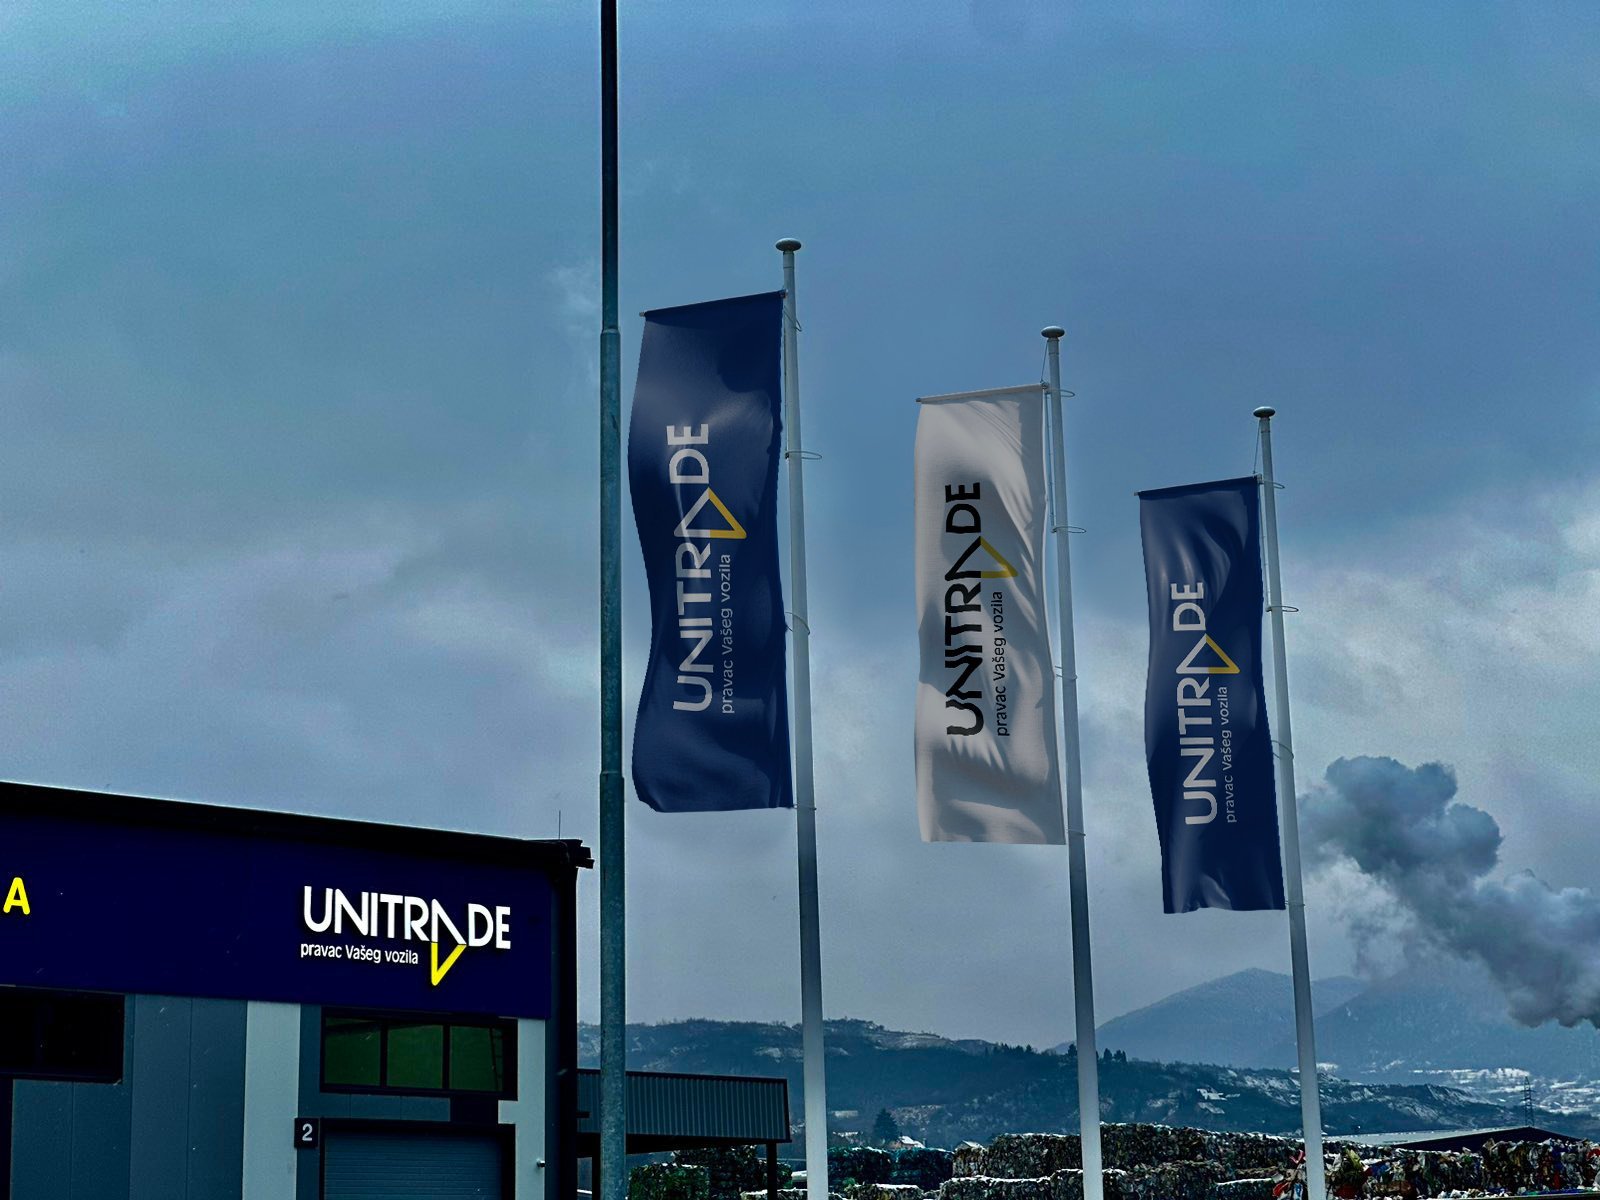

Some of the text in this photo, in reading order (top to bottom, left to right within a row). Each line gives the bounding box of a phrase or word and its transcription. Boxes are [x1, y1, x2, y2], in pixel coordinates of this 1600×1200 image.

[666, 423, 714, 712] UNITRADE
[718, 554, 735, 714] pravac Vašeg vozila
[945, 482, 984, 736] UNITRADE
[991, 591, 1010, 737] pravac Vašeg vozila
[1171, 582, 1218, 825] UNITRADE
[1217, 686, 1237, 823] pravac Vašeg vozila
[3, 877, 30, 915] A
[300, 943, 419, 964] pravac Vašeg vozila
[303, 886, 511, 949] UNITRADE
[302, 1123, 313, 1141] 2
